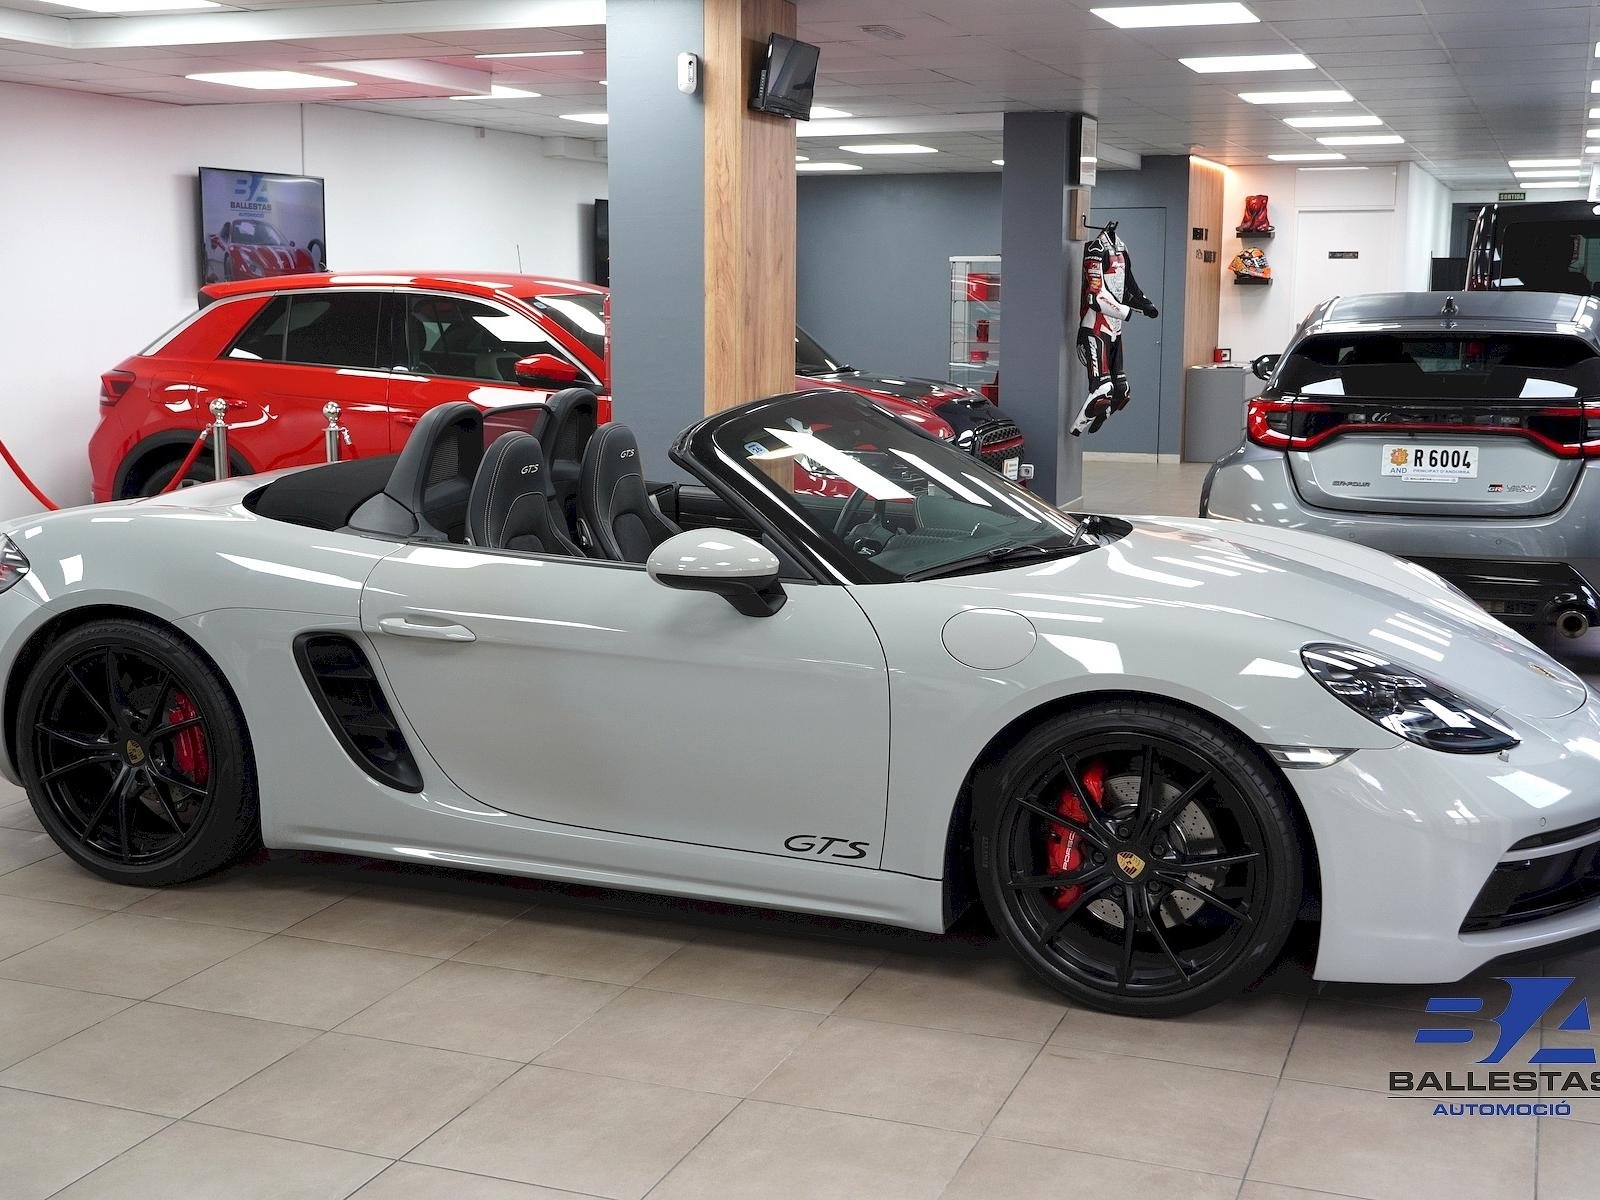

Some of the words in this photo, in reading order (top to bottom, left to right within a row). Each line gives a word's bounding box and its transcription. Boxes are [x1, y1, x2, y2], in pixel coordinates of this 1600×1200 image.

[620, 448, 635, 459] GTS
[1414, 449, 1424, 467] R
[1429, 449, 1471, 469] 6004
[520, 463, 539, 475] GTS
[784, 834, 870, 859] GTS
[1062, 830, 1076, 871] PORSC
